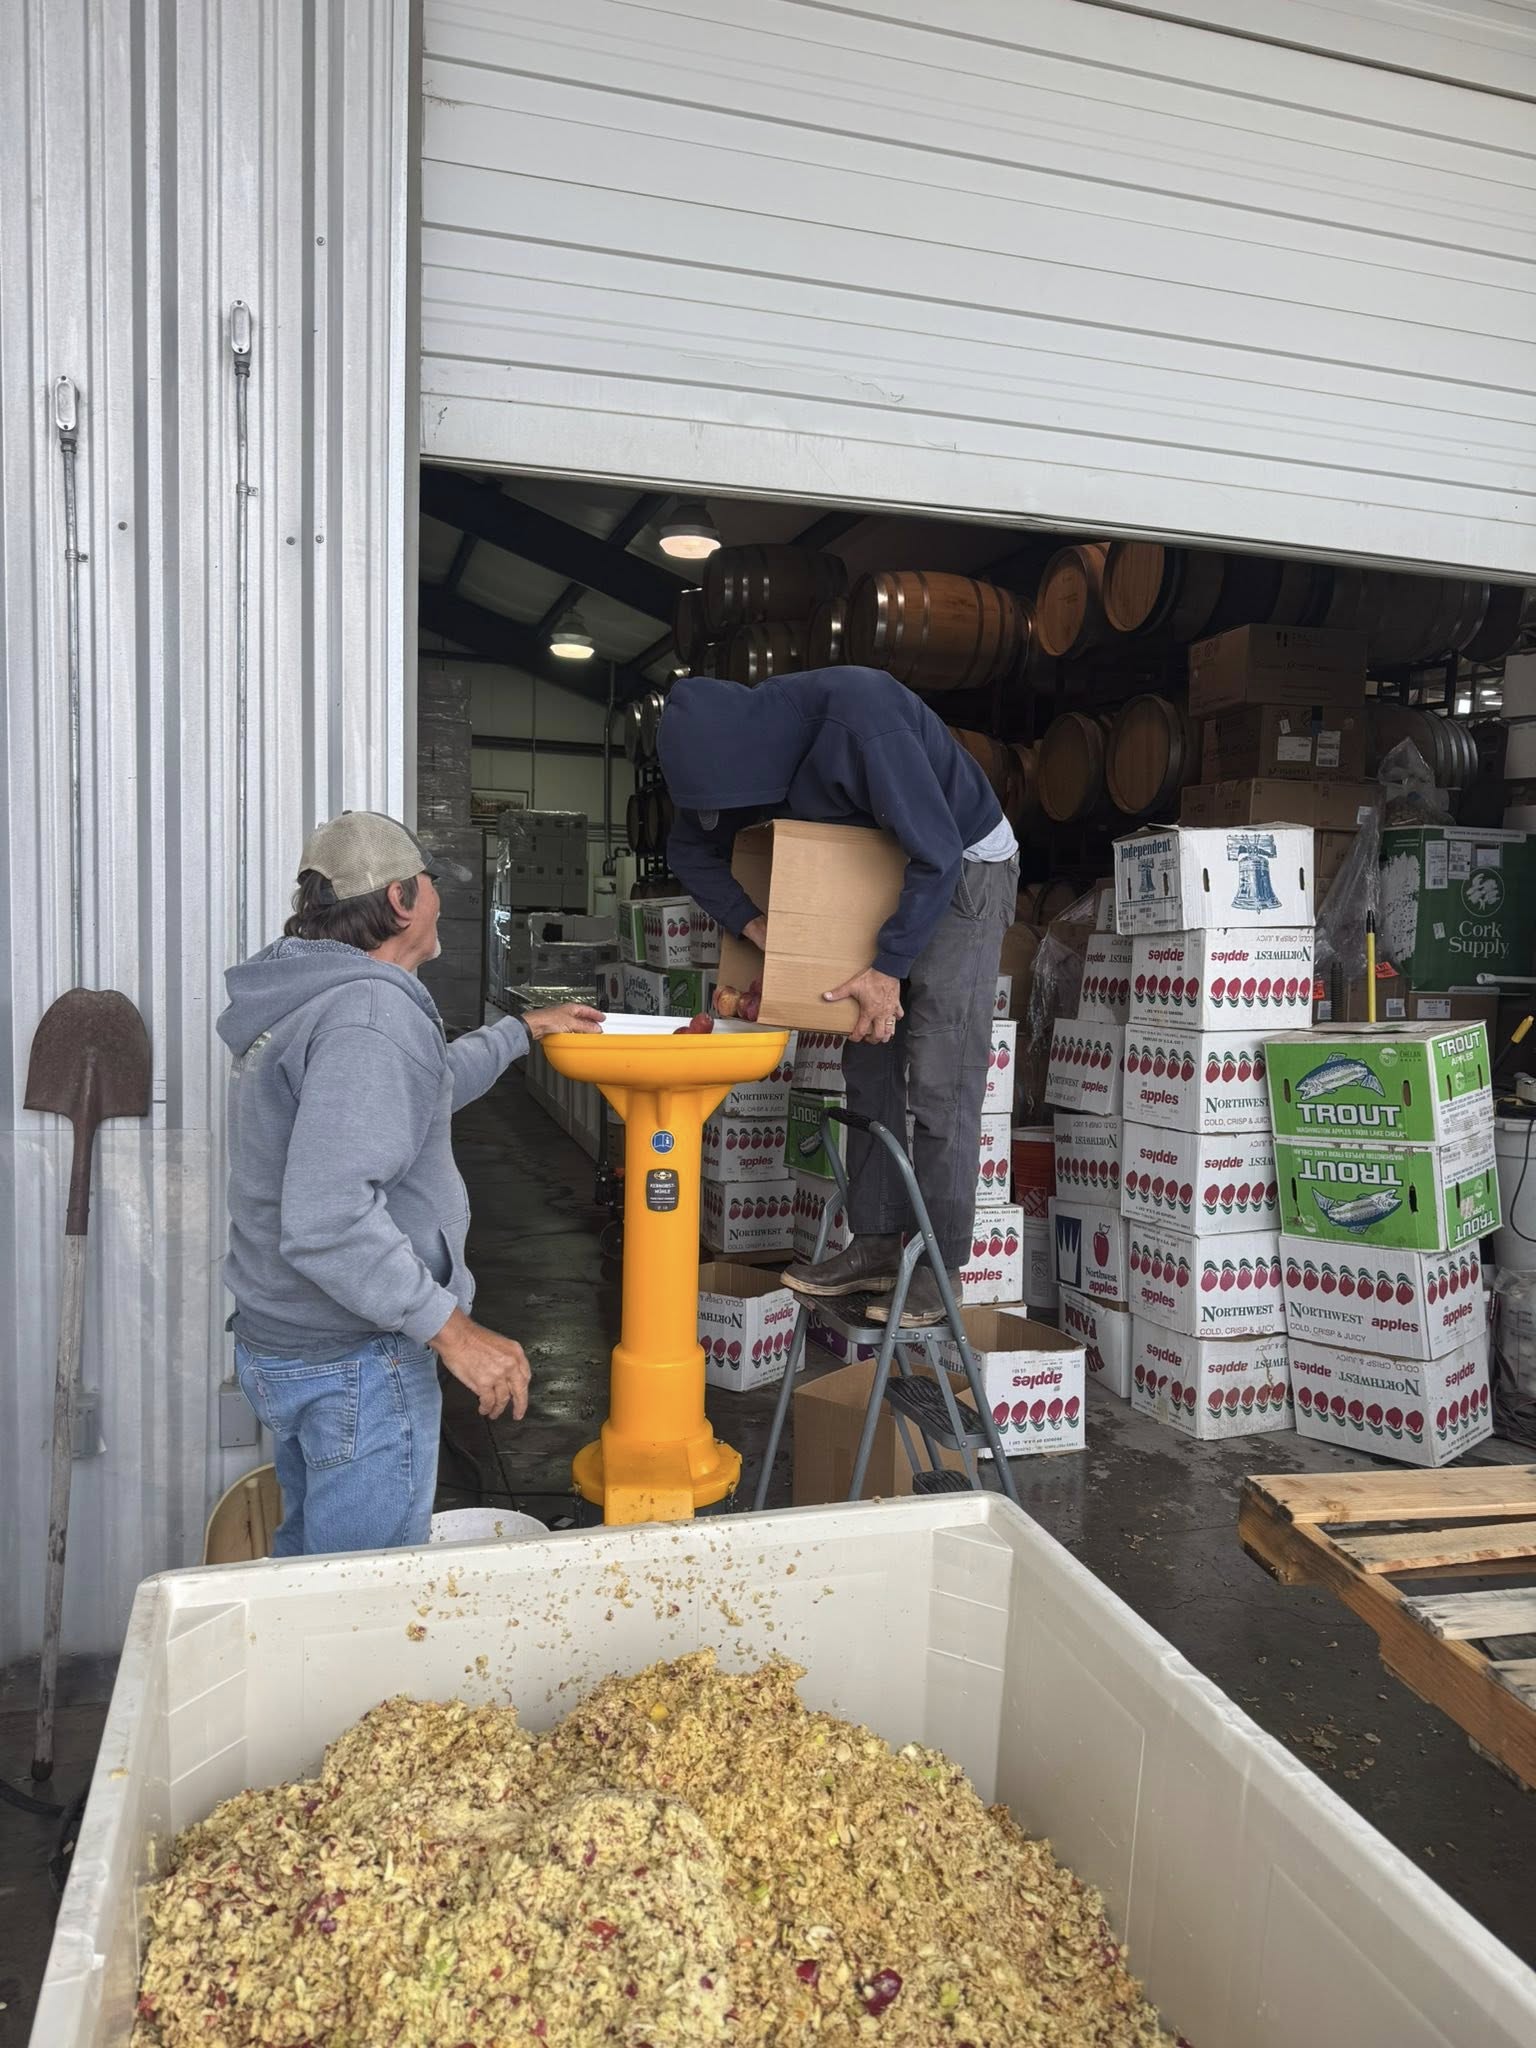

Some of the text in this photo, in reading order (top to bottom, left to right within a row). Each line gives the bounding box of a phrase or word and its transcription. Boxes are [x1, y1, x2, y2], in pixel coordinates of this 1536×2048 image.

[1121, 838, 1171, 862] Independent
[1458, 920, 1503, 938] Cork
[1148, 948, 1185, 964] apples
[1211, 946, 1312, 964] NORTHWEST apples
[1449, 936, 1510, 958] Supply
[1438, 1030, 1481, 1058] TROUT
[1082, 1080, 1108, 1094] apples
[730, 1090, 786, 1104] NORTHWEST
[1140, 1088, 1179, 1106] apples
[1205, 1096, 1270, 1114] NORTHWEST
[1227, 1117, 1248, 1126] CRISP
[1248, 1117, 1254, 1125] &
[1296, 1102, 1400, 1126] TROUT
[1296, 1126, 1331, 1134] WASHINGTON
[1075, 1134, 1118, 1148] NORTHWEST
[740, 1156, 774, 1168] apples
[1140, 1148, 1178, 1166] apples
[1204, 1156, 1244, 1170] apples
[1300, 1158, 1404, 1186] TROUT
[1455, 1208, 1496, 1243] TROUT
[729, 1228, 782, 1242] NORTHWEST
[960, 1268, 1003, 1284] apples
[1086, 1266, 1118, 1283] Northwest
[1089, 1280, 1118, 1296] apples
[1141, 1286, 1176, 1308] apples
[698, 1312, 743, 1328] NORTHW
[764, 1306, 794, 1325] apples
[1202, 1304, 1274, 1322] NORTHWEST
[1289, 1300, 1364, 1325] NORTHWEST
[1371, 1317, 1420, 1333] apples
[1442, 1302, 1473, 1327] apples
[1200, 1324, 1275, 1336] COLD, CRISP & JUICY
[1290, 1322, 1367, 1343] COLD, CRISP & JUICY
[1146, 1343, 1182, 1366] apples
[1208, 1362, 1248, 1376] apples
[1336, 1354, 1420, 1374] COLD, CRISP & JUICY
[1012, 1370, 1063, 1390] apples
[1293, 1360, 1422, 1397] NORTHWEST apples
[1445, 1362, 1476, 1388] apples
